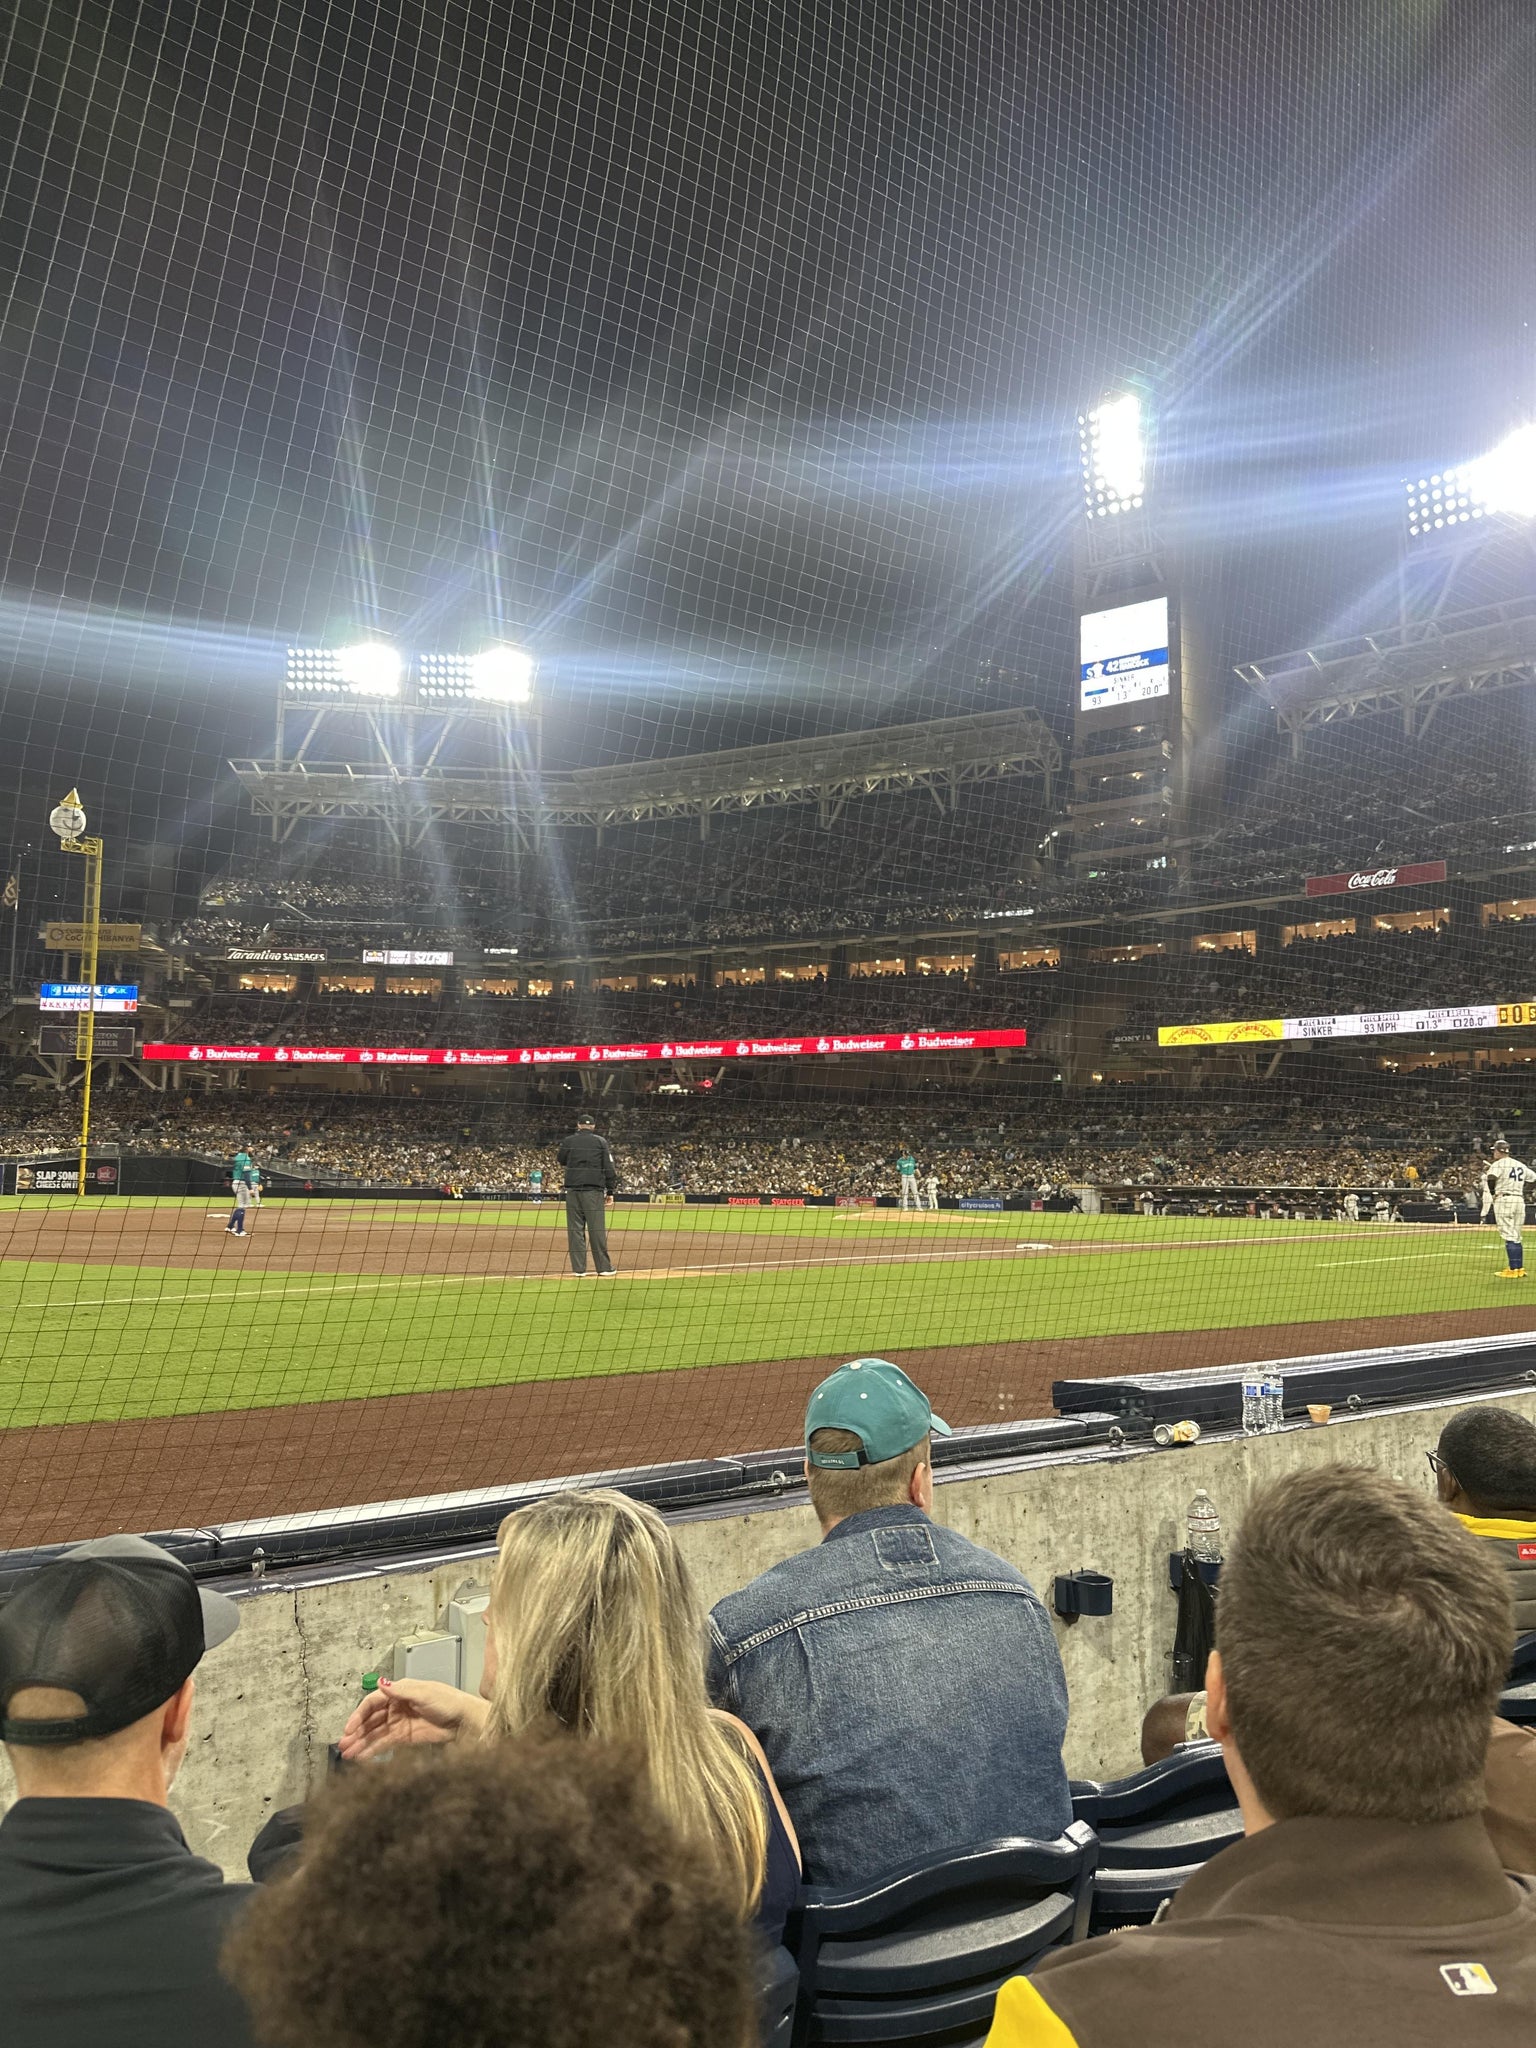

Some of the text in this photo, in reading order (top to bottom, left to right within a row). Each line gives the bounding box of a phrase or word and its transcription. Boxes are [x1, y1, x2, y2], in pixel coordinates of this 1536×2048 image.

[227, 948, 325, 961] Tarantino SAUSAGES
[1303, 1026, 1333, 1037] SINKER
[1364, 1022, 1397, 1034] 93 MPH
[206, 1036, 975, 1062] Budweiser Budweiser Budweiser Budweiser Budweiser Budweiser Budweiser Budweiser Budweiser Budweiser
[36, 1170, 79, 1181] SLAP SOME
[1509, 1167, 1524, 1181] 42
[36, 1181, 60, 1189] CHEESE
[61, 1181, 72, 1189] ON
[728, 1197, 761, 1206] SEATGEEK
[771, 1197, 805, 1207] SEATGEEK
